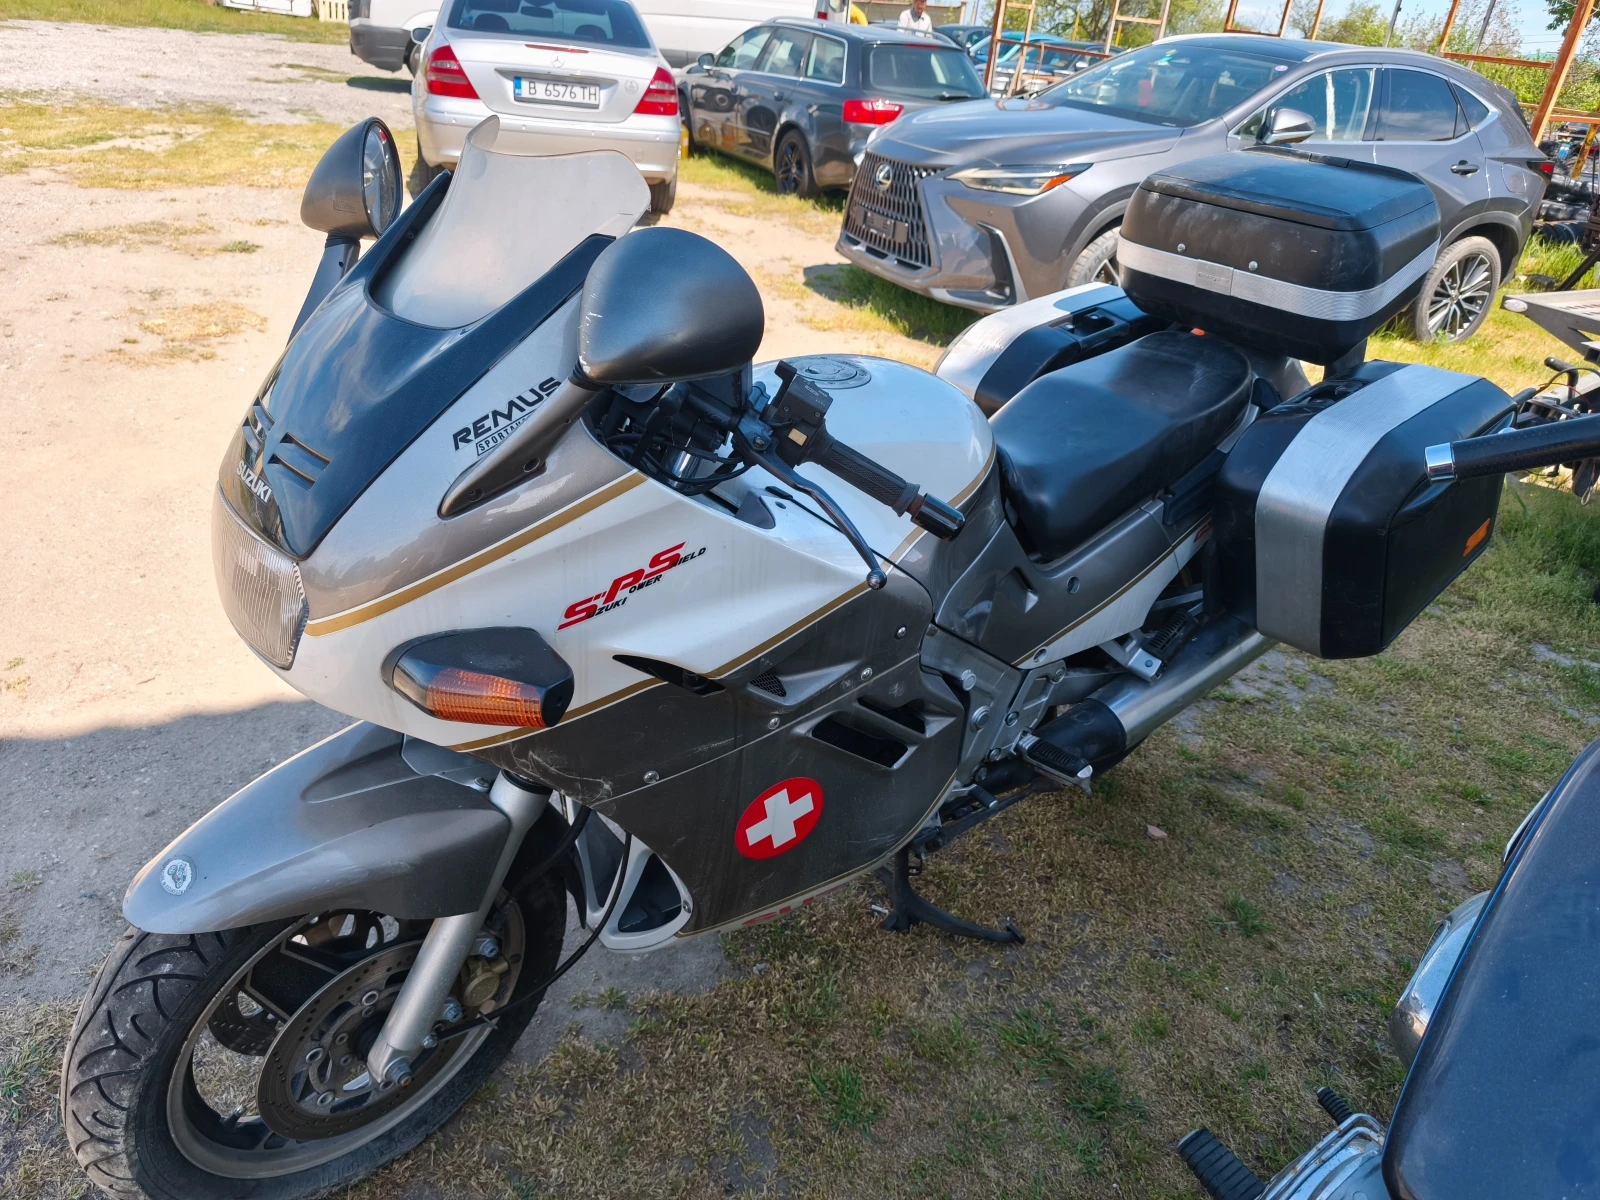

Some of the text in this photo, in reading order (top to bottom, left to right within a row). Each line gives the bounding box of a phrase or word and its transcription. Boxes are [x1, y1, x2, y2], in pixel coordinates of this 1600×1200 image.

[528, 81, 537, 96] B
[544, 83, 577, 100] 6576
[580, 86, 598, 101] TH
[452, 376, 562, 452] REMUS
[236, 459, 272, 503] SUZUKI
